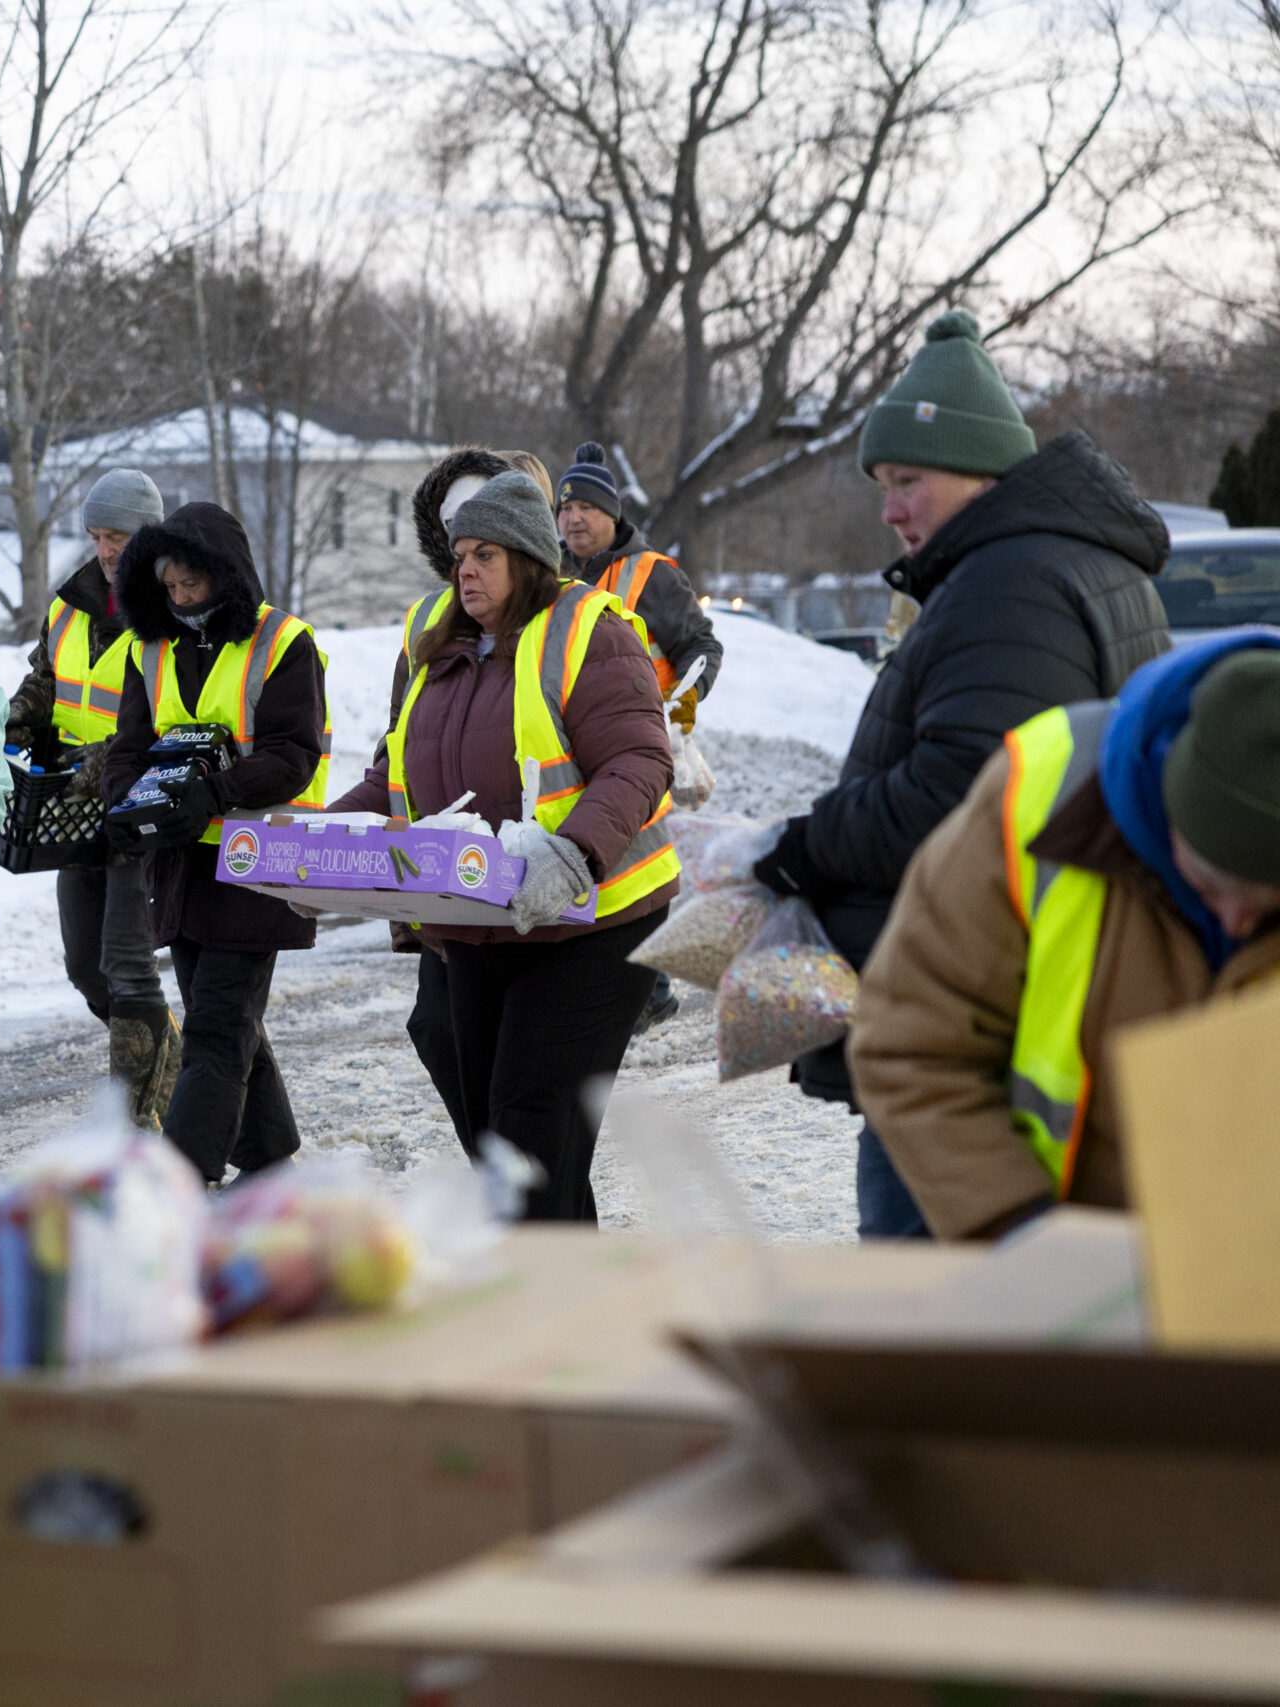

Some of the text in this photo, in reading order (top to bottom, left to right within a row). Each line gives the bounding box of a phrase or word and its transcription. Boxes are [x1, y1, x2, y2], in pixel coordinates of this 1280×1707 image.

[265, 841, 300, 857] INSPIRED
[226, 852, 258, 863] SUNSET
[265, 857, 297, 873] FLAVOR
[304, 848, 389, 874] MINI CUCUMBERS
[458, 865, 485, 879] SUNSET
